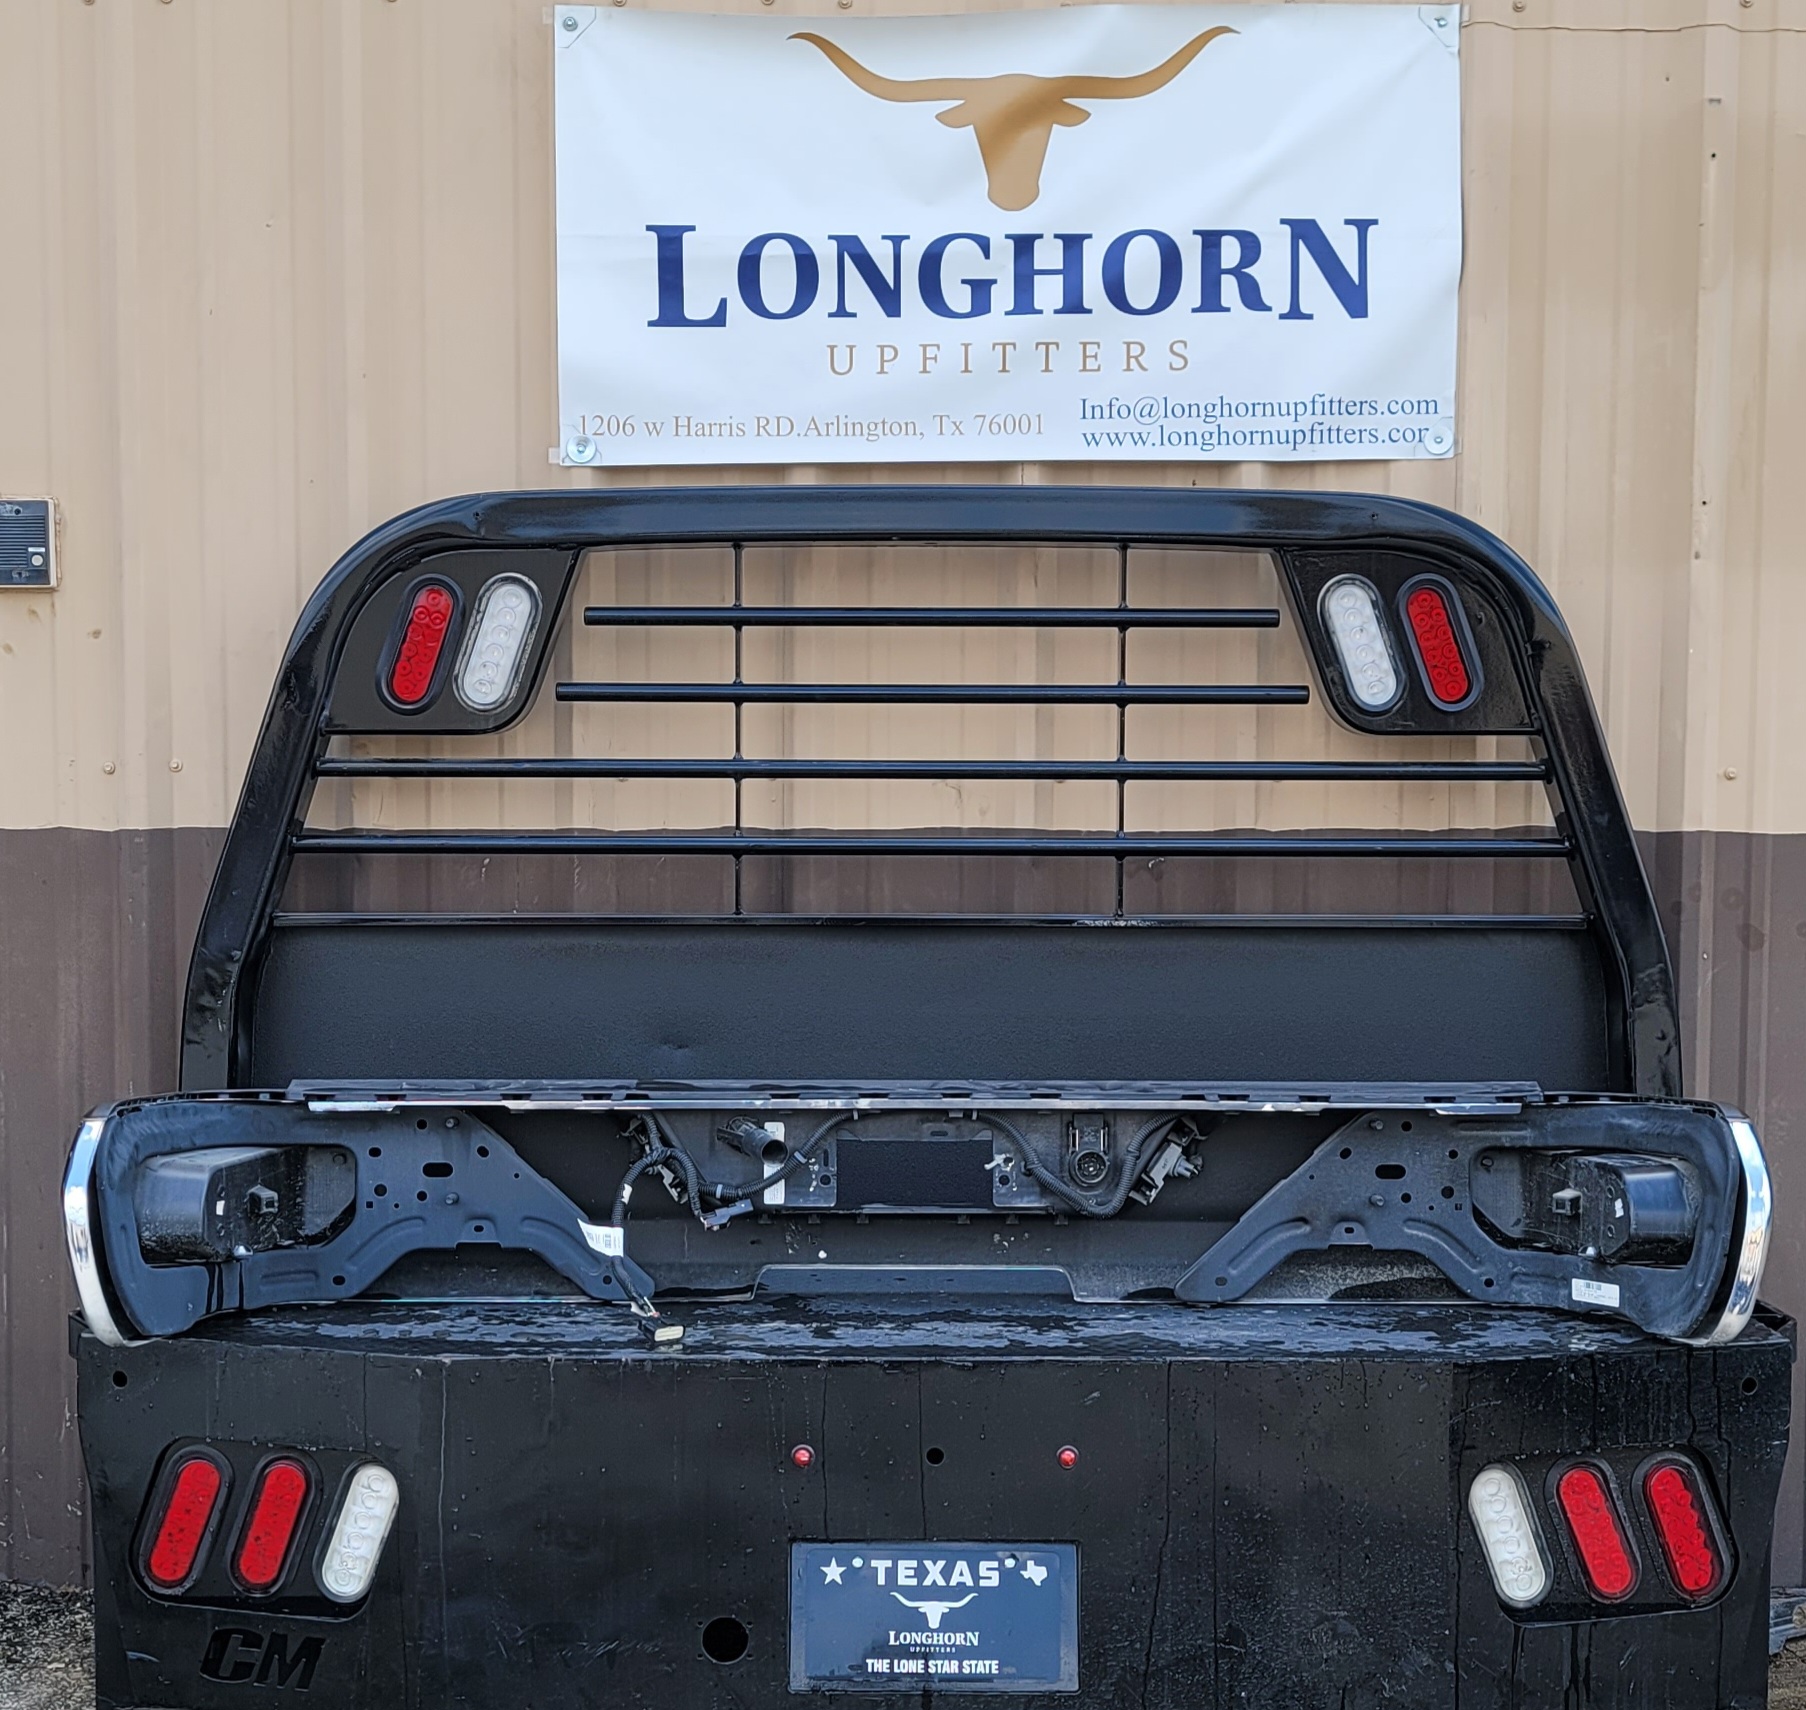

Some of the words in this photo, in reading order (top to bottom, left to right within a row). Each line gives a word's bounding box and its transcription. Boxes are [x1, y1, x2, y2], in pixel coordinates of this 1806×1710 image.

[645, 217, 1379, 329] LONGHORN
[826, 339, 1189, 376] UPFITTERS
[1079, 393, 1440, 426] Info@longhornupfitters.com
[579, 413, 637, 438] 1206
[642, 421, 665, 437] w
[673, 415, 746, 438] Harris
[755, 414, 926, 443] RD.Arlington,
[932, 414, 966, 436] Tx
[973, 413, 1044, 436] 76001
[870, 1559, 1001, 1587] TEXAS
[888, 1630, 980, 1647] LONGHORN
[200, 1627, 327, 1692] CM
[865, 1658, 891, 1674] THE
[893, 1658, 926, 1674] LONE
[927, 1659, 960, 1675] STAR
[961, 1659, 1000, 1675] STATE
